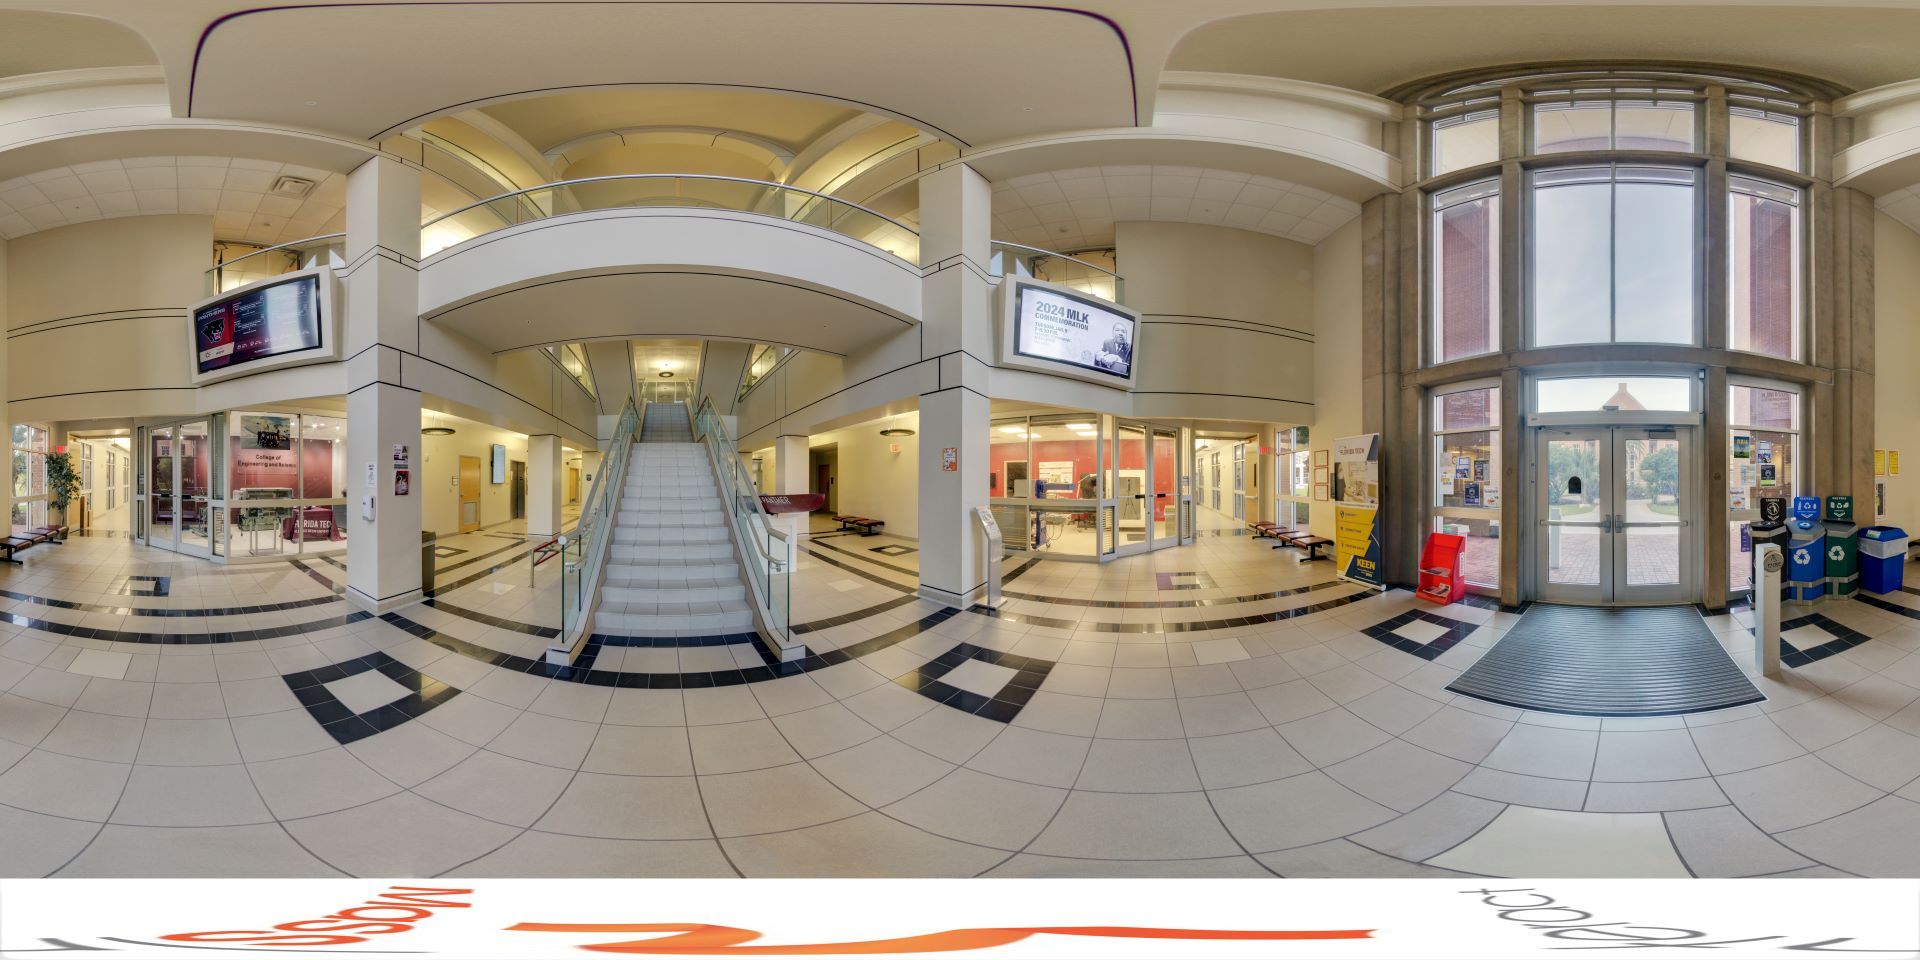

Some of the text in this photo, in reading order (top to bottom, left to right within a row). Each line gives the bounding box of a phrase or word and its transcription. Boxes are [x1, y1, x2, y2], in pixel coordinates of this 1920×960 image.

[1036, 301, 1089, 324] 2024 MLK
[1034, 313, 1089, 331] COMMEMORATION
[238, 460, 268, 468] Engineering
[761, 496, 792, 504] PANTHER
[1356, 558, 1376, 571] KEEN
